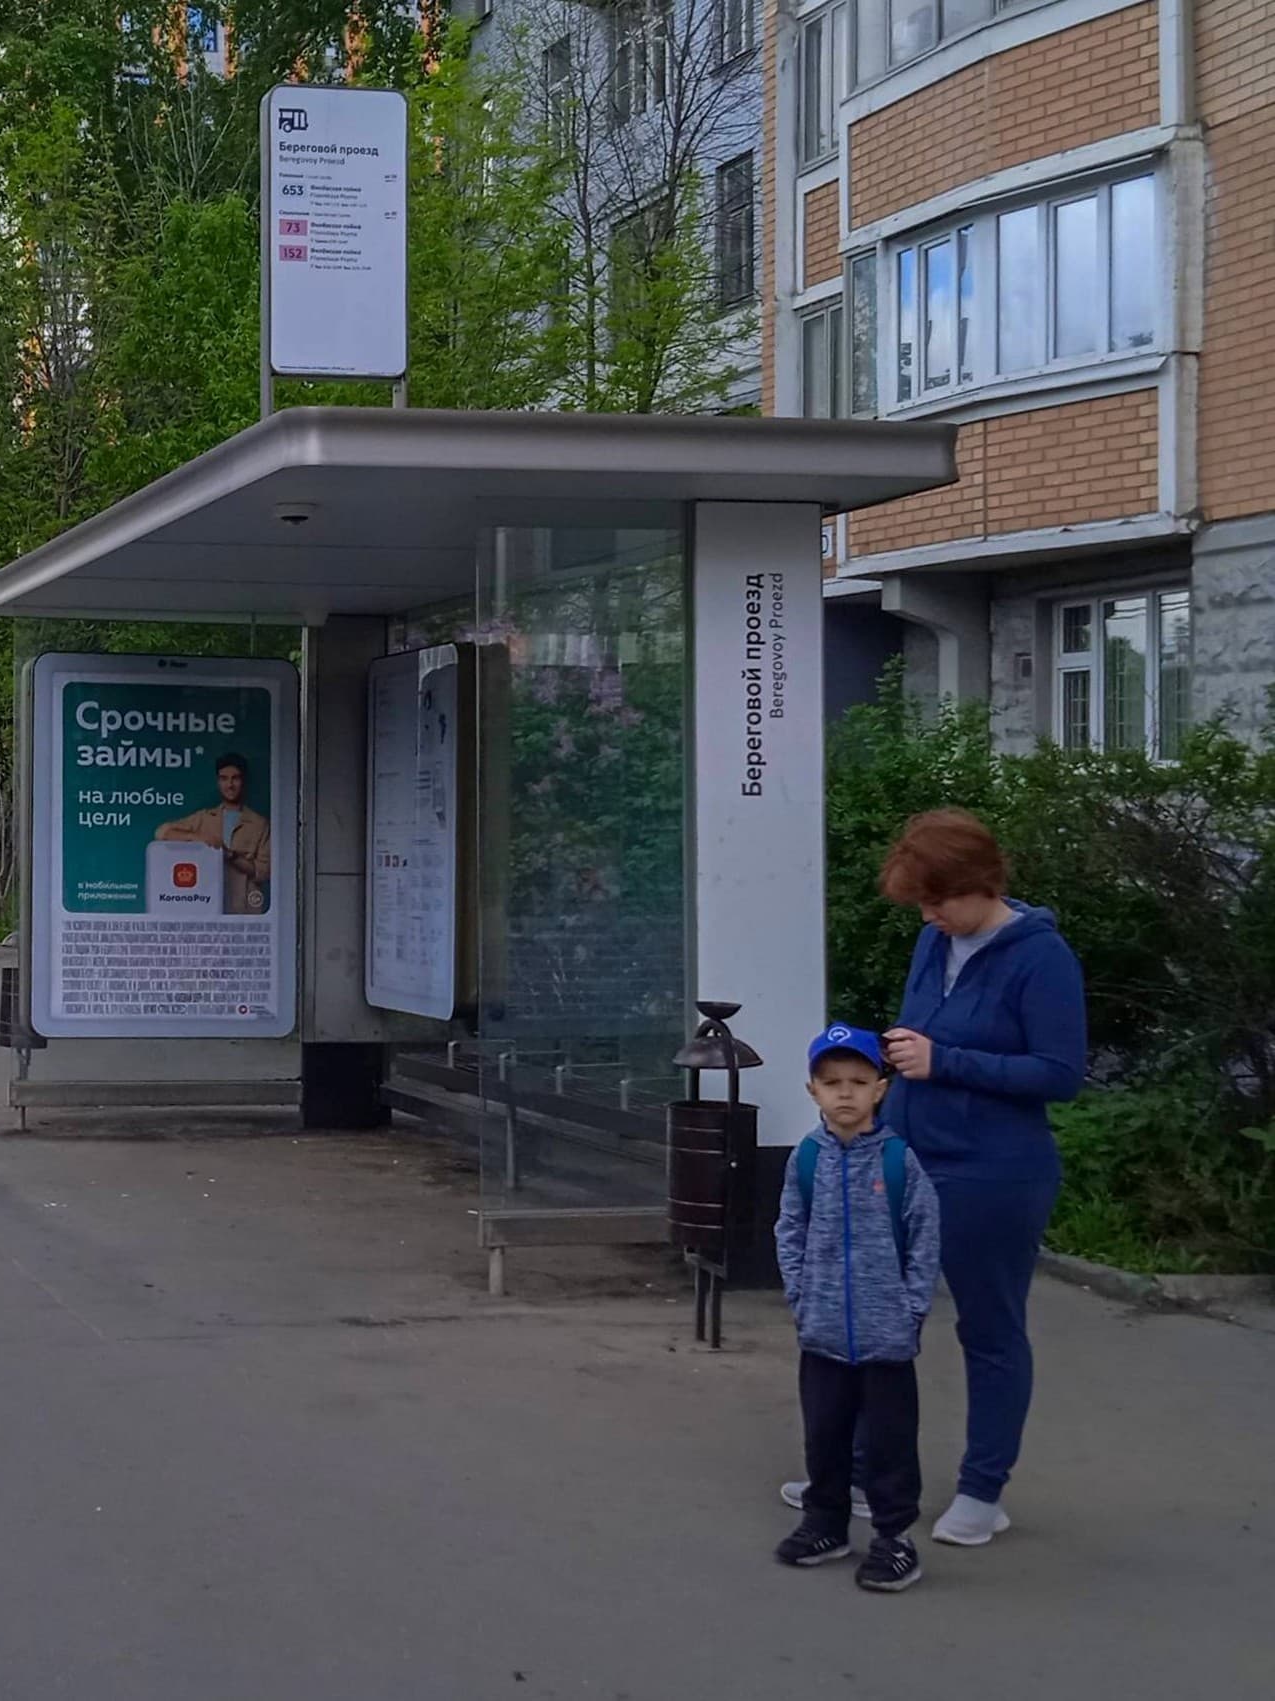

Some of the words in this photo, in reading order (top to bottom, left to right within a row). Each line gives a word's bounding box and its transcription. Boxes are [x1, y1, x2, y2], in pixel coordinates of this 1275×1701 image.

[279, 141, 337, 155] Береговой
[339, 145, 379, 157] проезд
[282, 185, 304, 196] 653
[286, 222, 300, 234] 73
[283, 248, 302, 259] 152
[769, 573, 784, 629] Proezd
[746, 573, 766, 660] проезд
[769, 635, 787, 718] Beregovoy
[76, 701, 236, 738] Срочные
[742, 669, 767, 797] Береговой
[79, 790, 104, 804] на
[110, 788, 184, 805] любые
[79, 812, 131, 828] цели
[159, 894, 211, 904] KoronaPay
